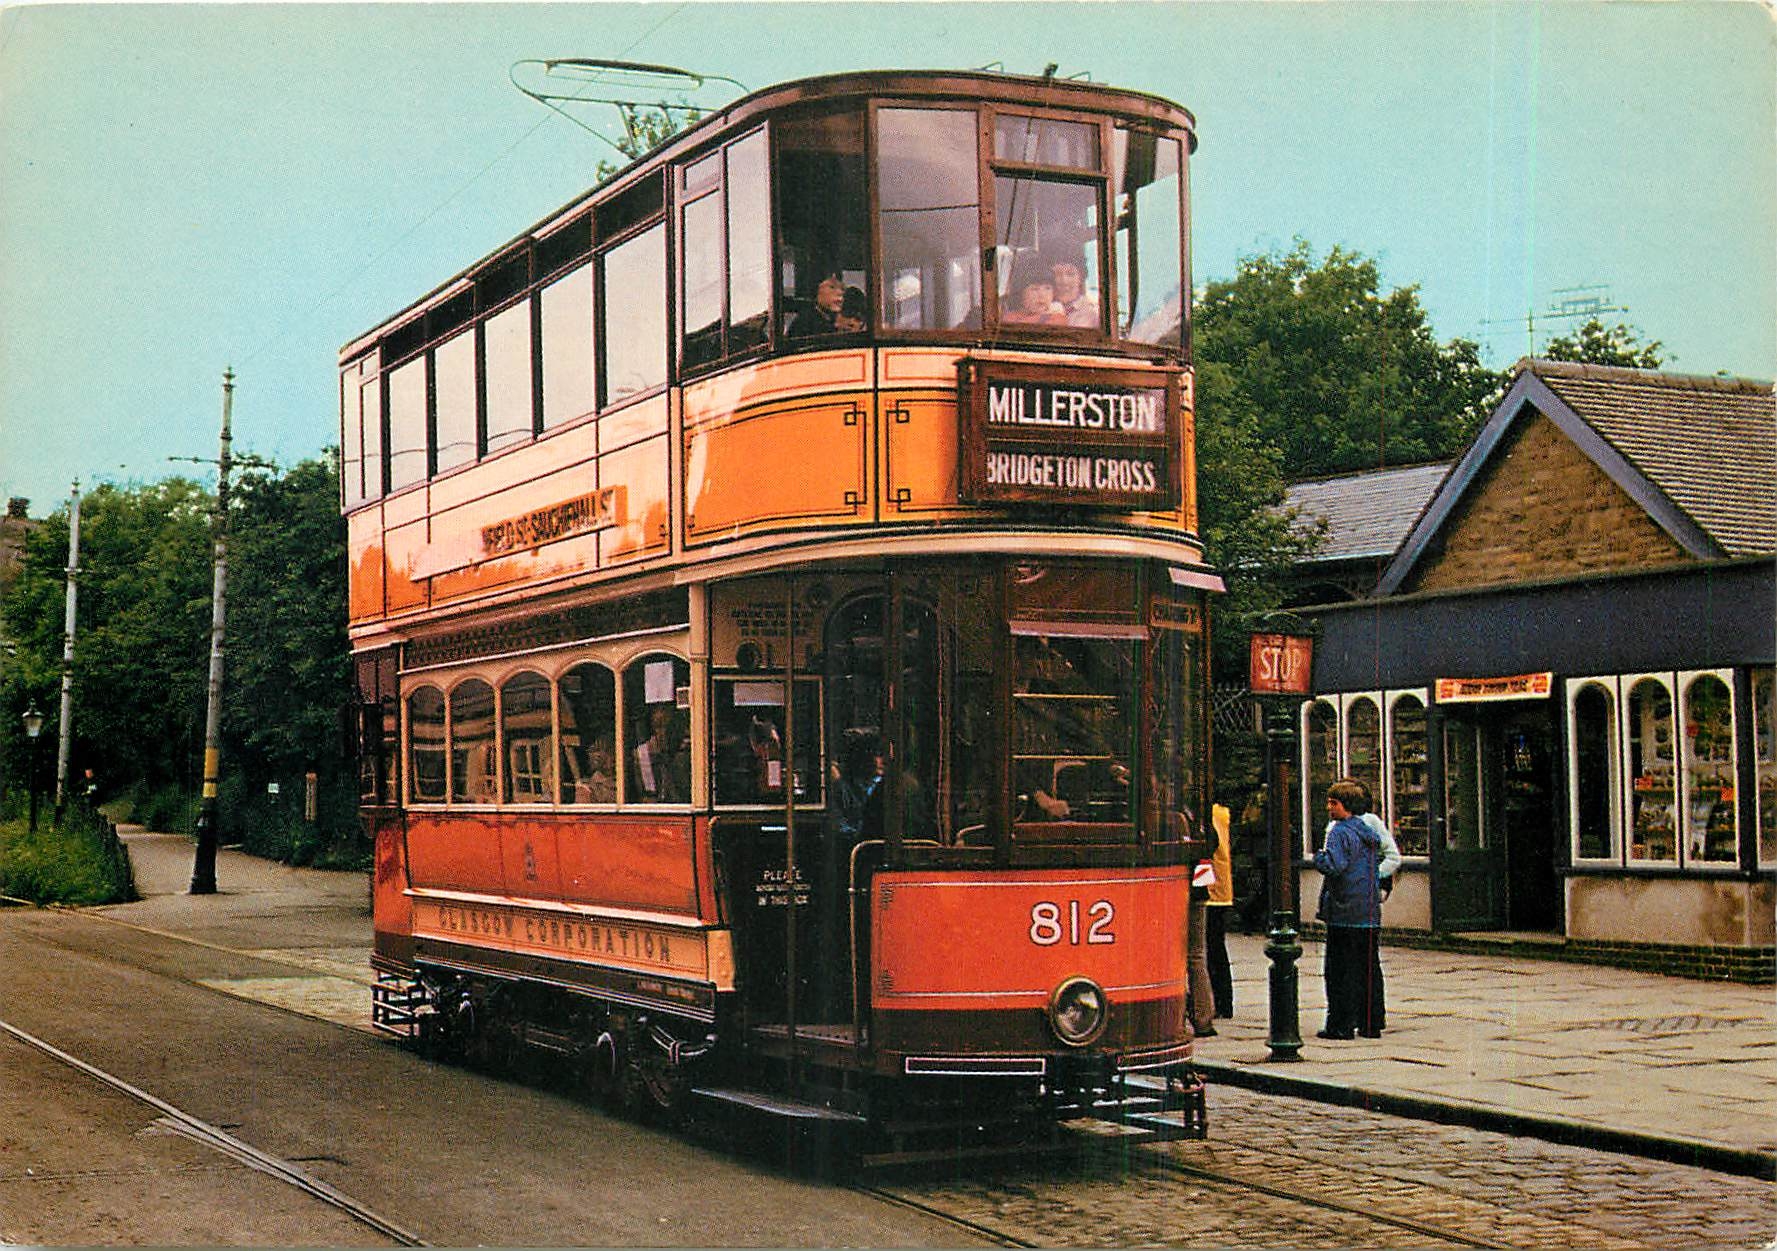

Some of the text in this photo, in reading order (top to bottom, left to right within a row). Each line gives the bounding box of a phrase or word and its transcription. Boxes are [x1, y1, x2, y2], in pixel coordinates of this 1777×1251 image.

[989, 387, 1158, 432] MILLERSTON
[986, 452, 1156, 492] BRIDGETON CROSS
[1260, 646, 1302, 681] STOP
[526, 917, 671, 963] CORPORATION
[1029, 900, 1116, 946] 812
